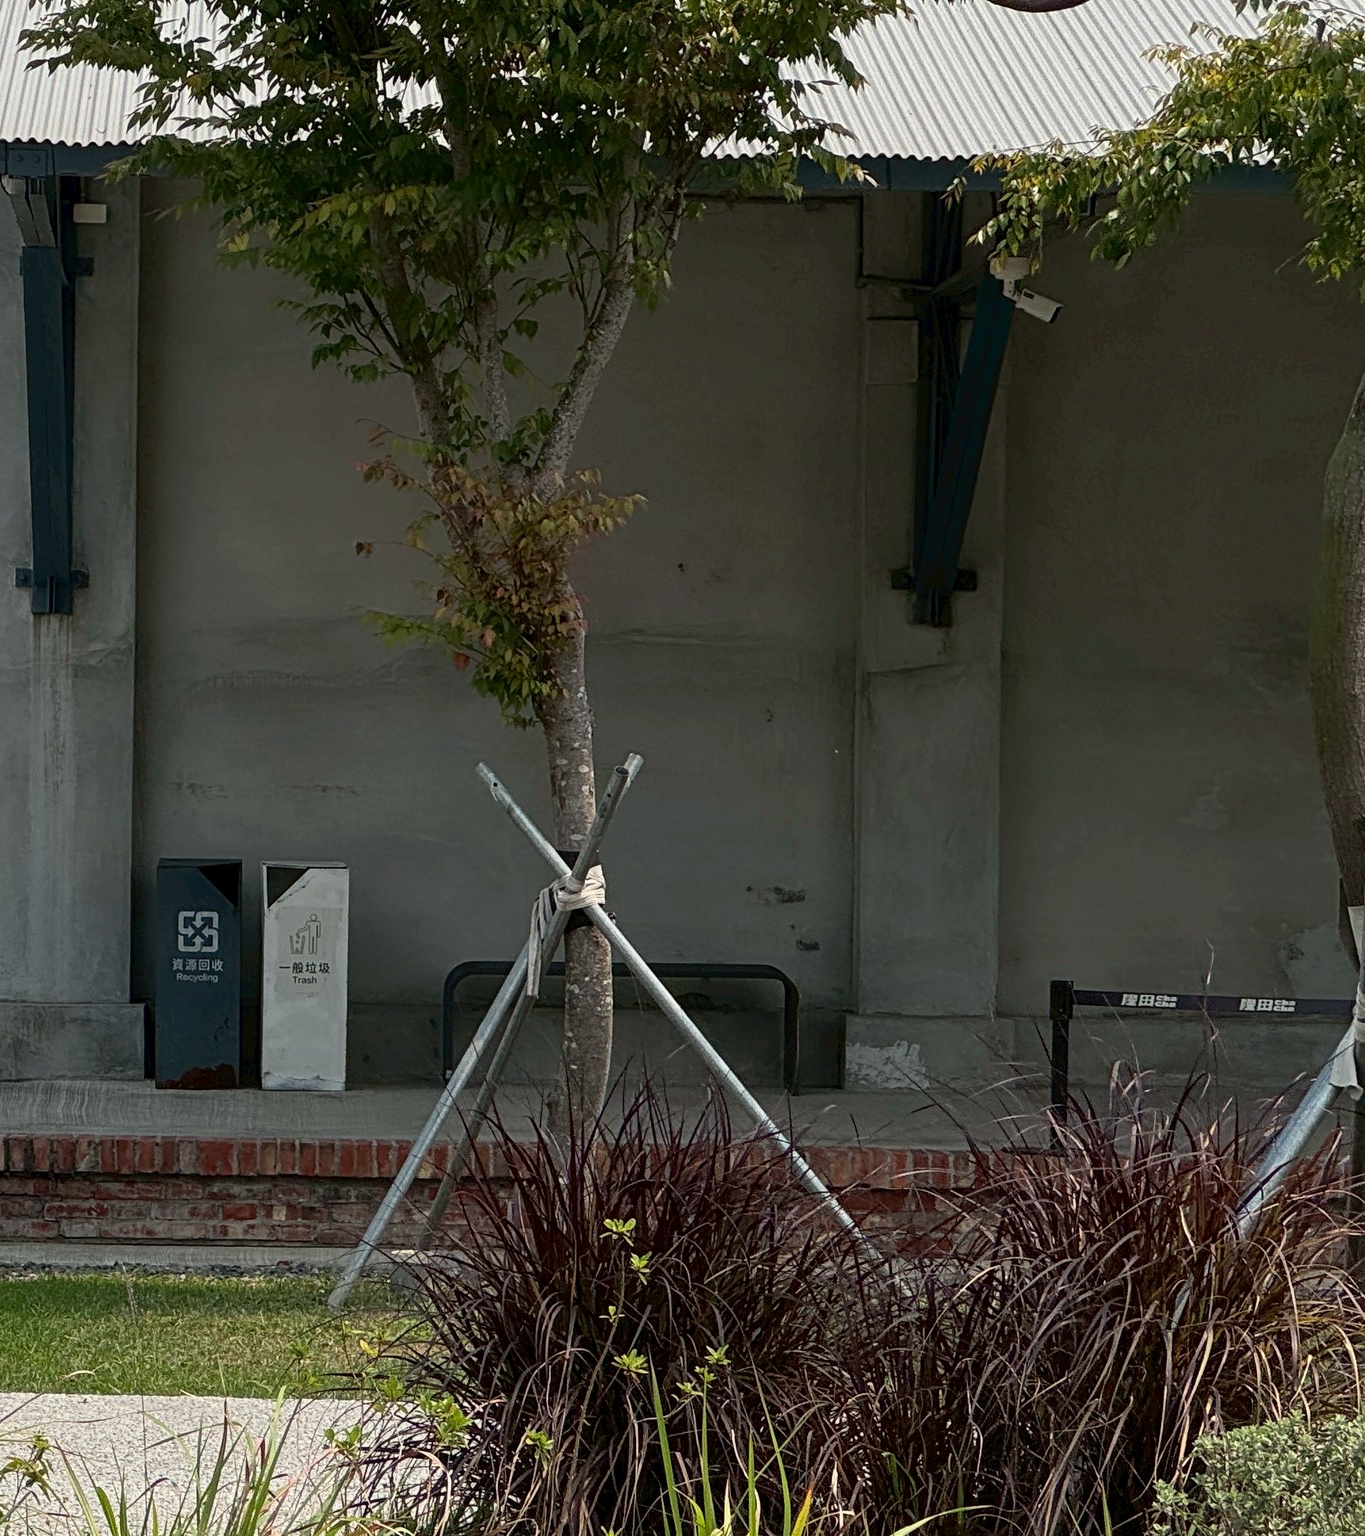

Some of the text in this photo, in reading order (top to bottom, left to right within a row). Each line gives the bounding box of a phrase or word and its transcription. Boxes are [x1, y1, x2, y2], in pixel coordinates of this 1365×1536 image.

[172, 958, 224, 972] 資源回收
[279, 962, 330, 974] 一般垃圾
[176, 972, 219, 983] Recycling
[292, 976, 317, 985] Trash
